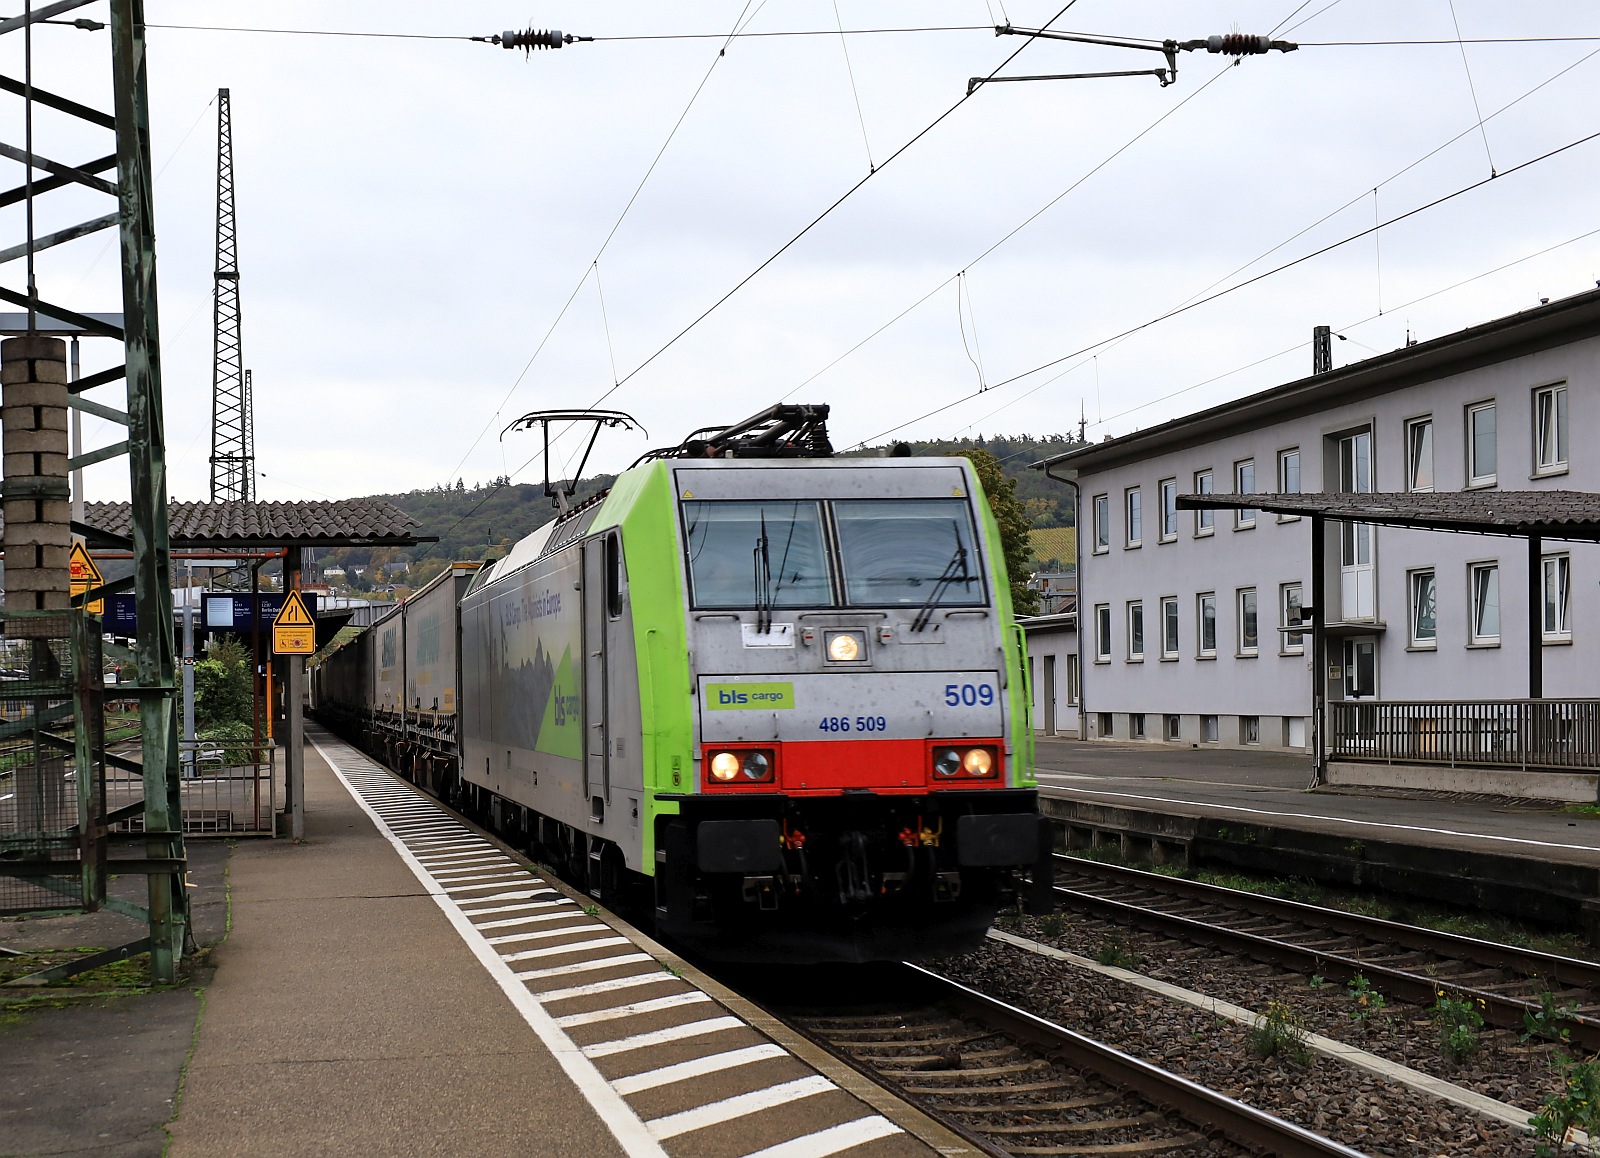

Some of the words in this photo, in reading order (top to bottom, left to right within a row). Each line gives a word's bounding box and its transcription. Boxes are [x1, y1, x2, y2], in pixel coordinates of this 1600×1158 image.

[554, 684, 565, 726] bls
[718, 690, 748, 705] bls
[752, 692, 784, 702] cargo
[945, 683, 995, 708] 509
[819, 715, 851, 733] 486
[855, 715, 887, 732] 509
